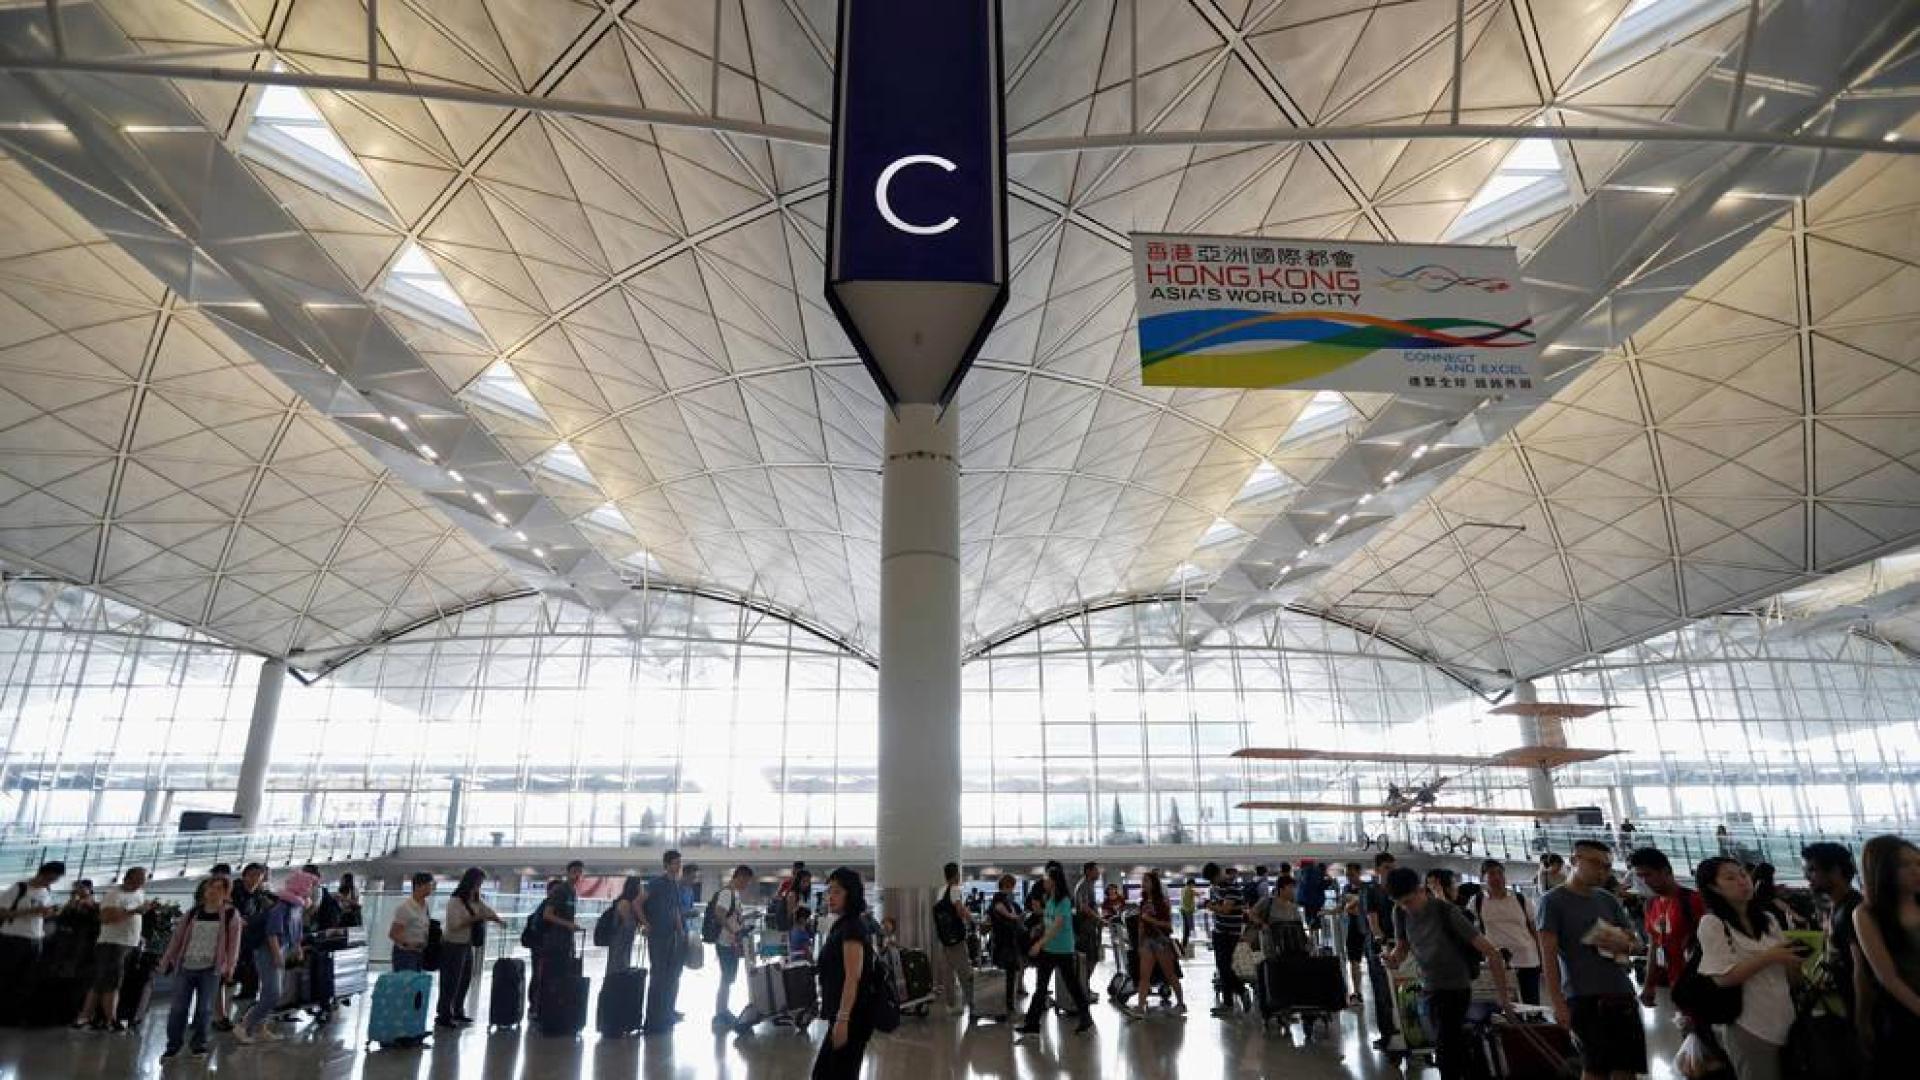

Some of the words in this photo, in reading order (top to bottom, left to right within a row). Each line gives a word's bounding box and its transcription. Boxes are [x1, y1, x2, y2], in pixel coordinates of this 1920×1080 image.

[875, 154, 960, 235] C
[1147, 264, 1250, 287] HONG
[1258, 267, 1361, 291] KONG
[1151, 287, 1221, 301] ASIA'S
[1226, 289, 1306, 305] WORLD
[1311, 292, 1361, 306] CITY
[1404, 351, 1475, 362] CONNECT
[1444, 362, 1476, 373] AND
[1481, 363, 1529, 374] EXCEL
